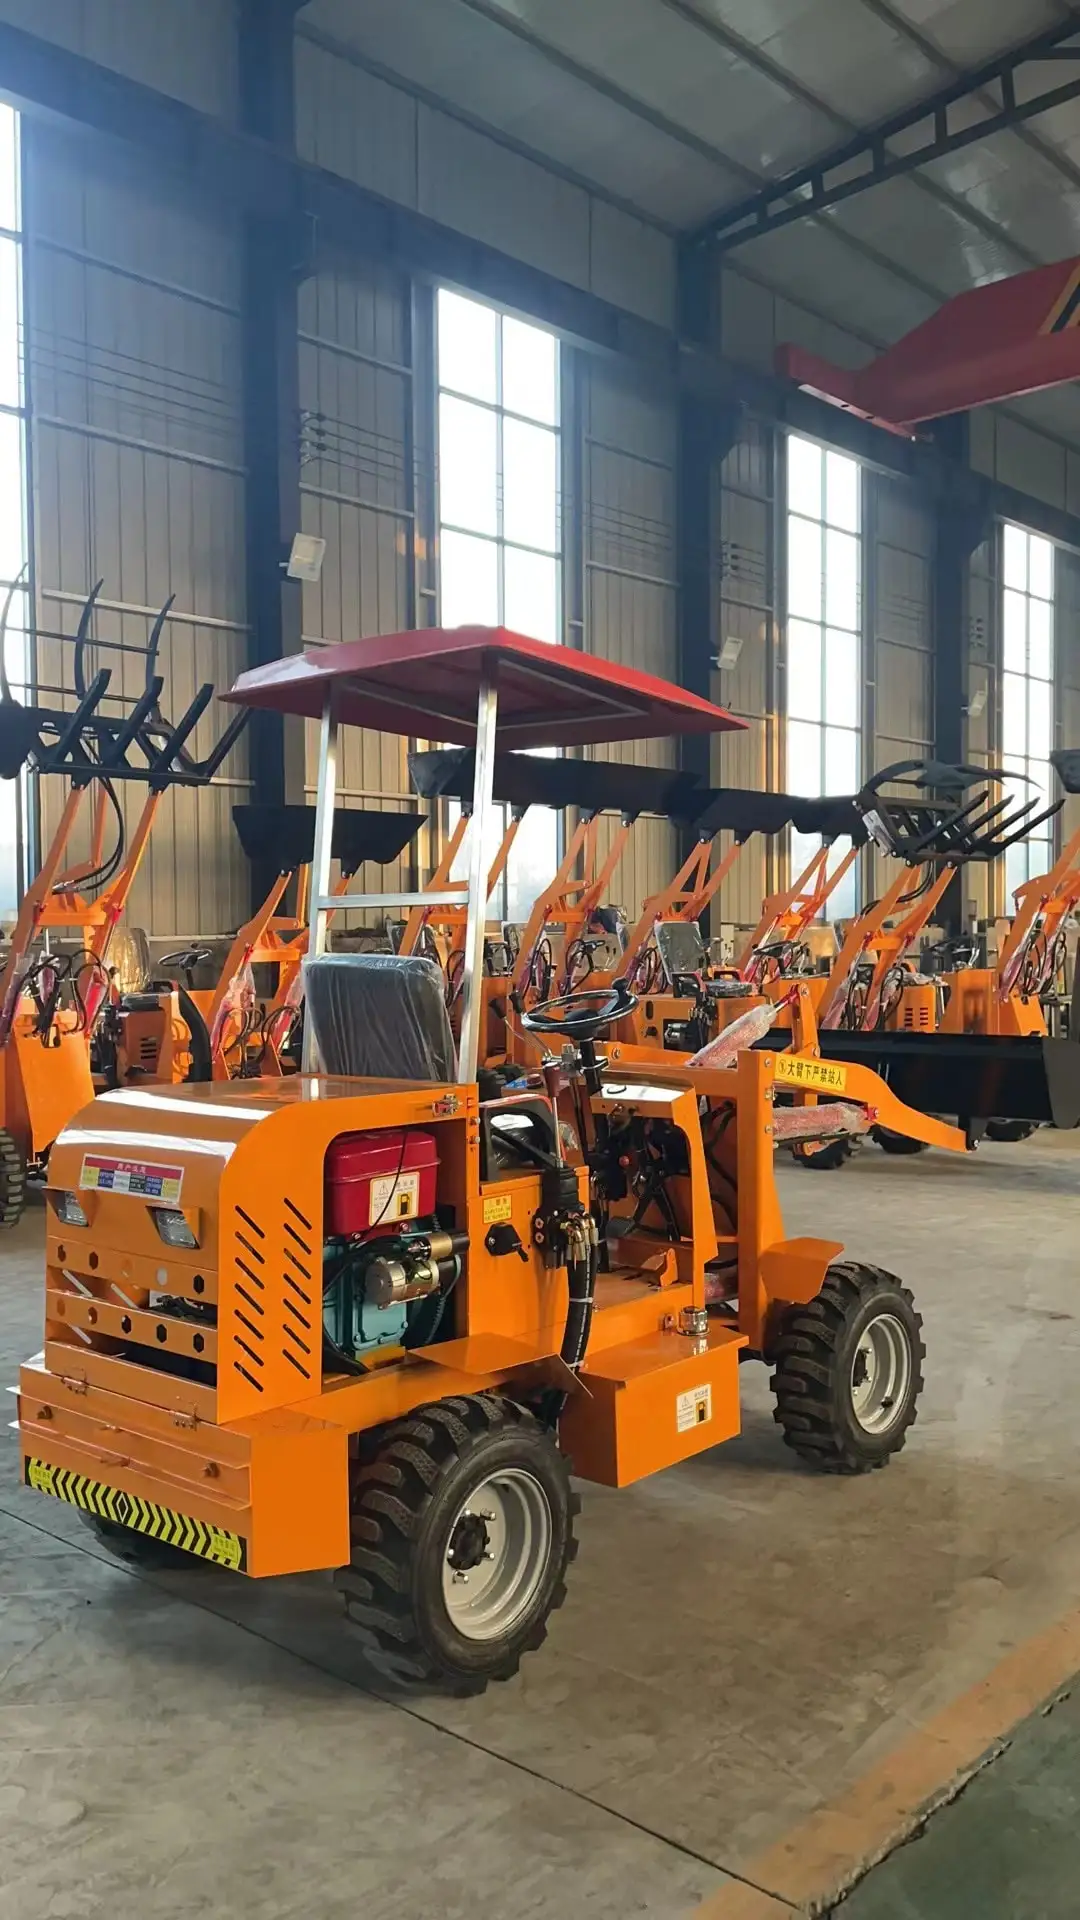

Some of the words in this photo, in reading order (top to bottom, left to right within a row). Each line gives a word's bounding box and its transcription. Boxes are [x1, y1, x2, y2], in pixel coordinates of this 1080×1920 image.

[787, 1060, 842, 1086] 大臂下严禁站人
